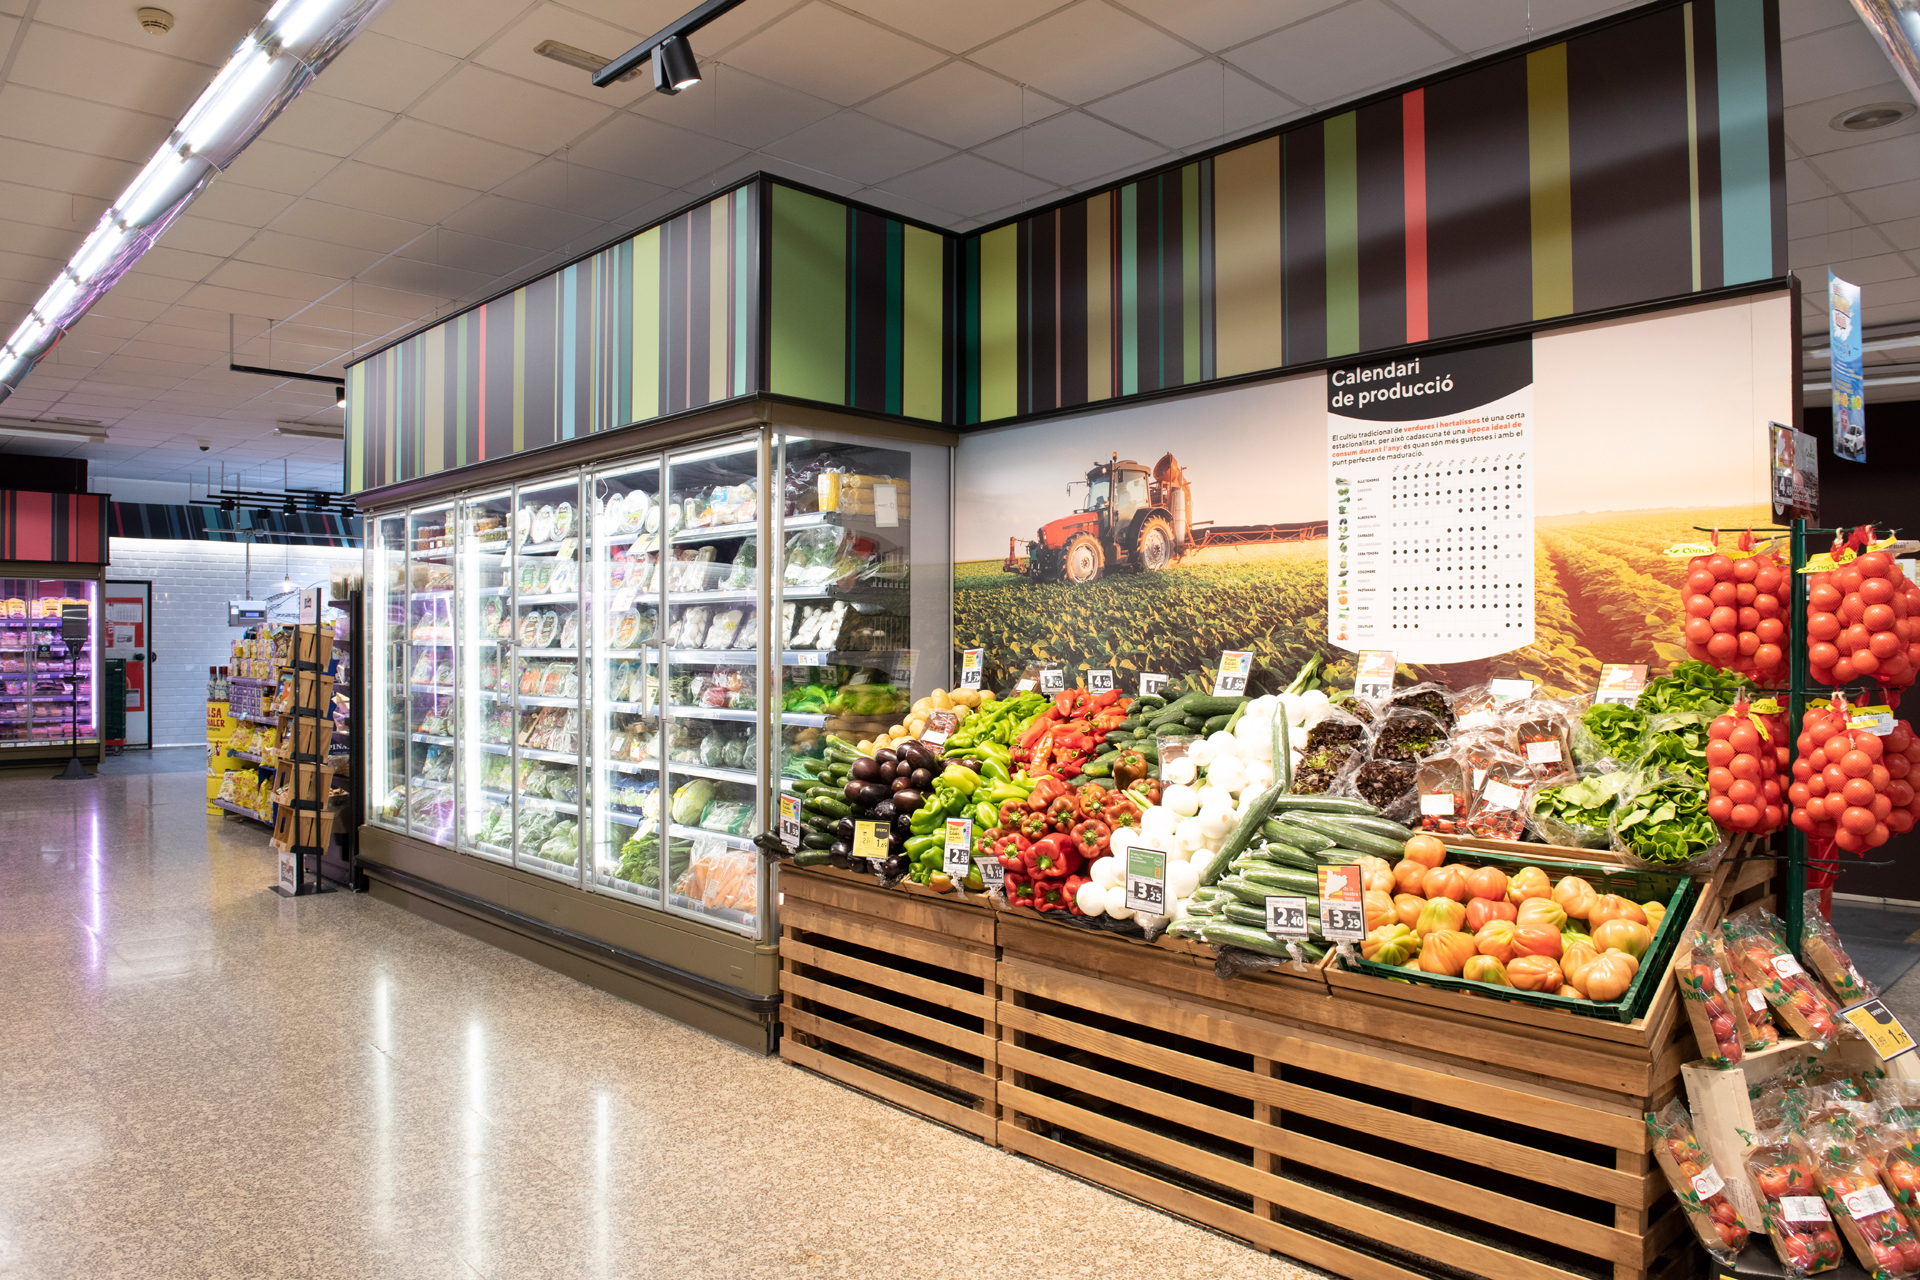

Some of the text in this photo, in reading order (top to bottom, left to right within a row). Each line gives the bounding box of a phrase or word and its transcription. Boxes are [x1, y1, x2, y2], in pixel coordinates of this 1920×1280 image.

[1331, 357, 1420, 387] Calendari
[1331, 373, 1454, 409] de producció
[1332, 439, 1377, 450] estacionalitat,
[1378, 438, 1390, 446] per
[1390, 435, 1405, 443] això
[1405, 432, 1442, 441] cadascuna
[1466, 426, 1490, 434] època
[1491, 422, 1511, 430] ideal
[1339, 432, 1357, 441] cultiu
[1358, 427, 1393, 438] tradicional
[1403, 424, 1435, 432] verdures
[1439, 418, 1480, 428] hortalisses
[1481, 415, 1489, 423] té
[1505, 412, 1525, 420] certa
[1332, 450, 1358, 458] consum
[1359, 446, 1382, 455] durant
[1411, 442, 1430, 450] quan
[1430, 439, 1443, 447] són
[1444, 437, 1459, 445] més
[1460, 434, 1493, 444] gustoses
[1497, 431, 1514, 439] amb
[1515, 429, 1523, 437] el
[1332, 458, 1347, 467] punt
[1348, 455, 1376, 466] perfecte
[1386, 450, 1424, 460] maduració.
[1094, 675, 1112, 688] 4,49
[1225, 677, 1245, 690] 1,99
[951, 849, 969, 864] 2,35
[1138, 883, 1162, 902] 3,25
[1277, 907, 1304, 928] 2,40
[1332, 910, 1361, 930] 3,29
[1805, 1239, 1839, 1255] Conca
